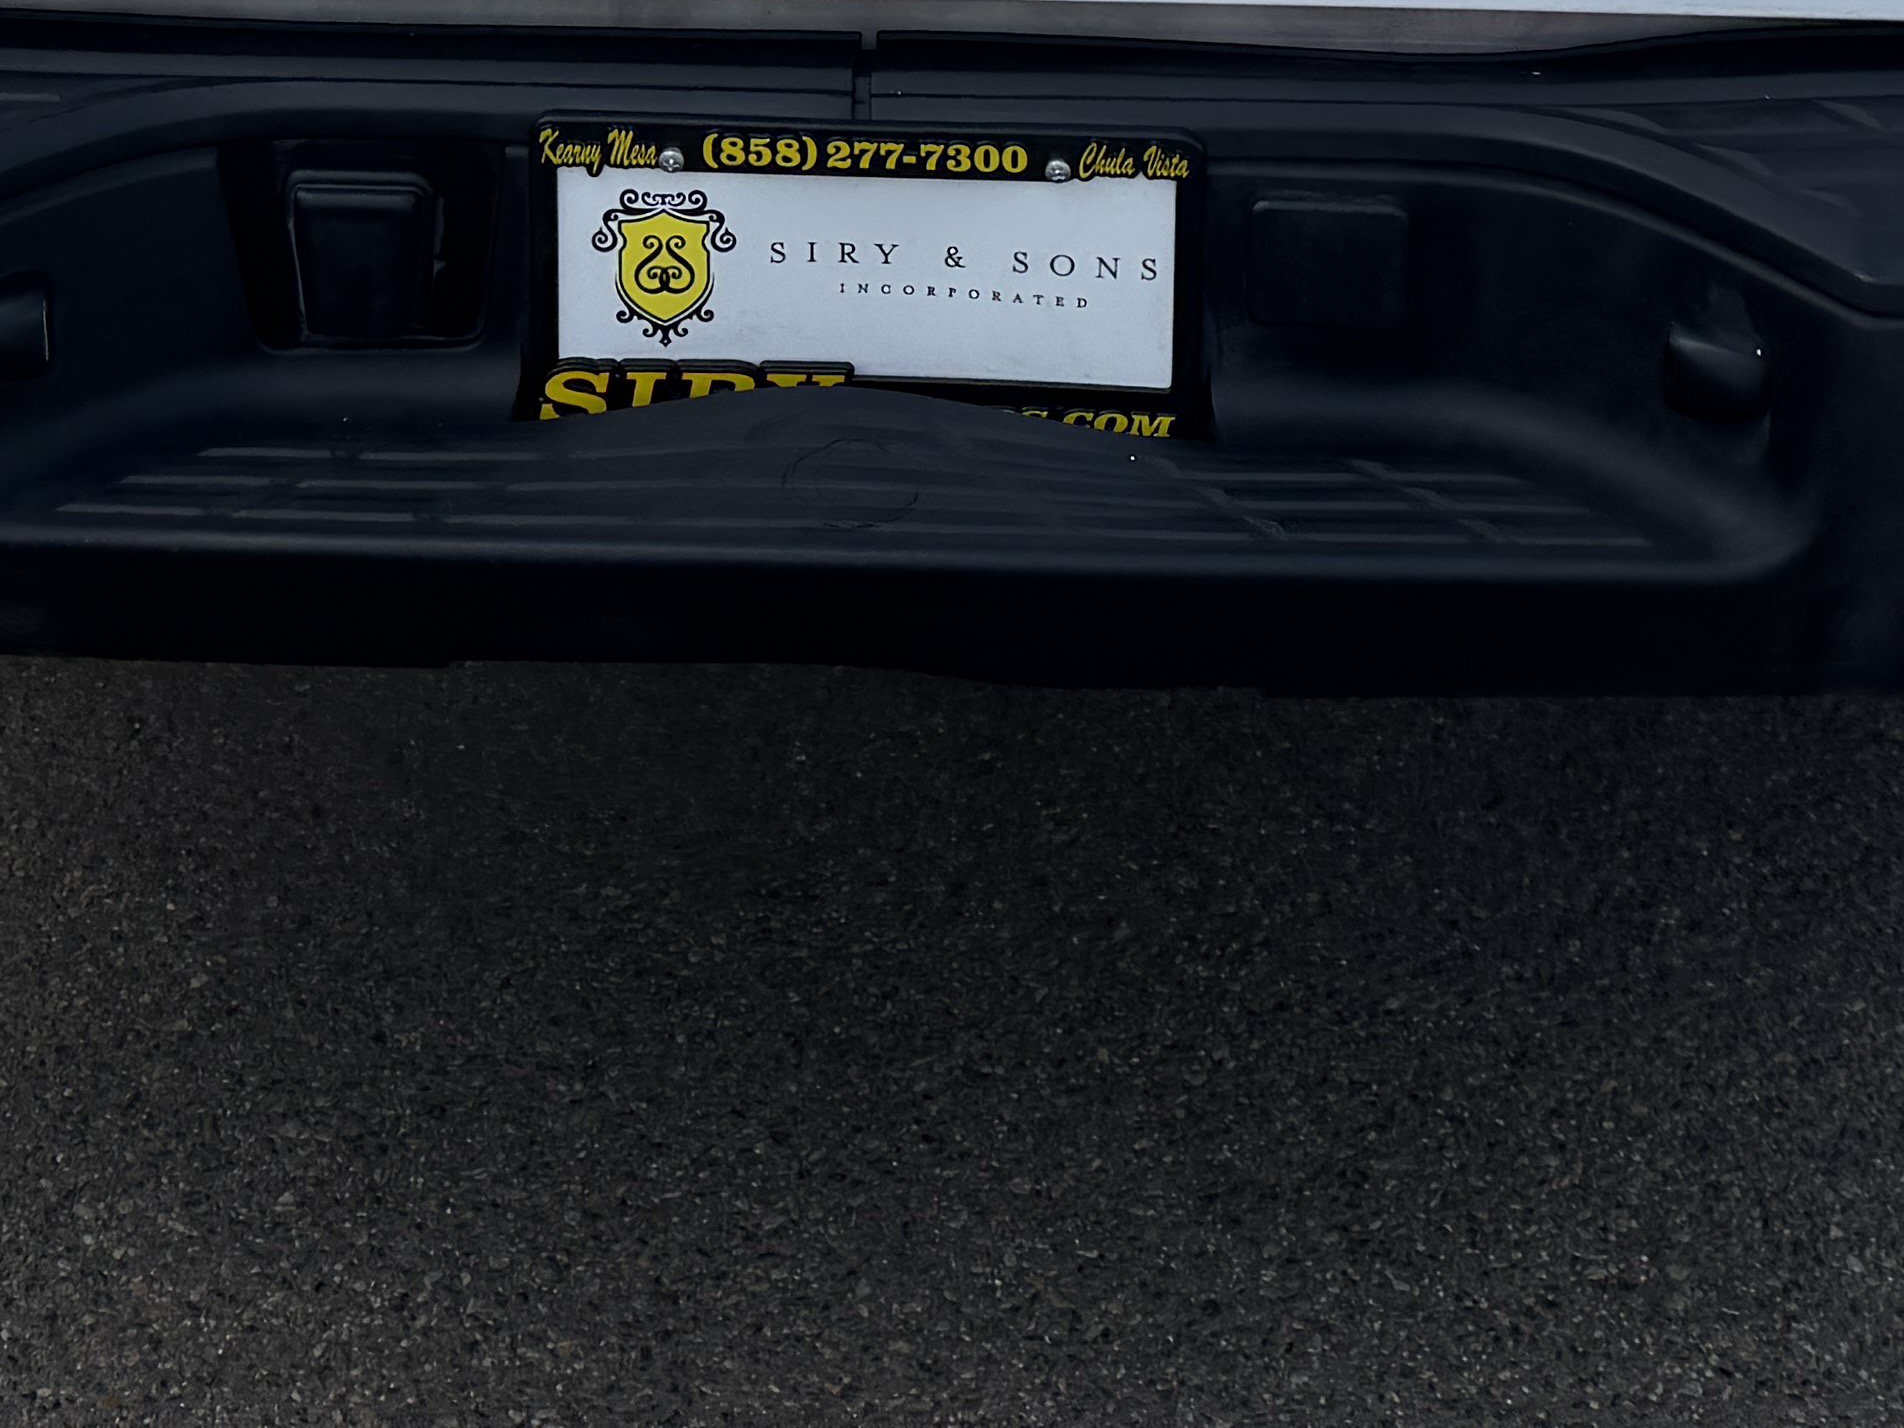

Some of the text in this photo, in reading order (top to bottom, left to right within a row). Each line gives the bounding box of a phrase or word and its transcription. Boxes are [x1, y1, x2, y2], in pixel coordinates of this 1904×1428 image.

[539, 128, 1191, 179] Kearny Mesa (858) 277-7300 Chula Vista
[769, 240, 1159, 282] SIRY & SONS
[839, 282, 1090, 309] INCORPORATED
[539, 371, 846, 421] SI
